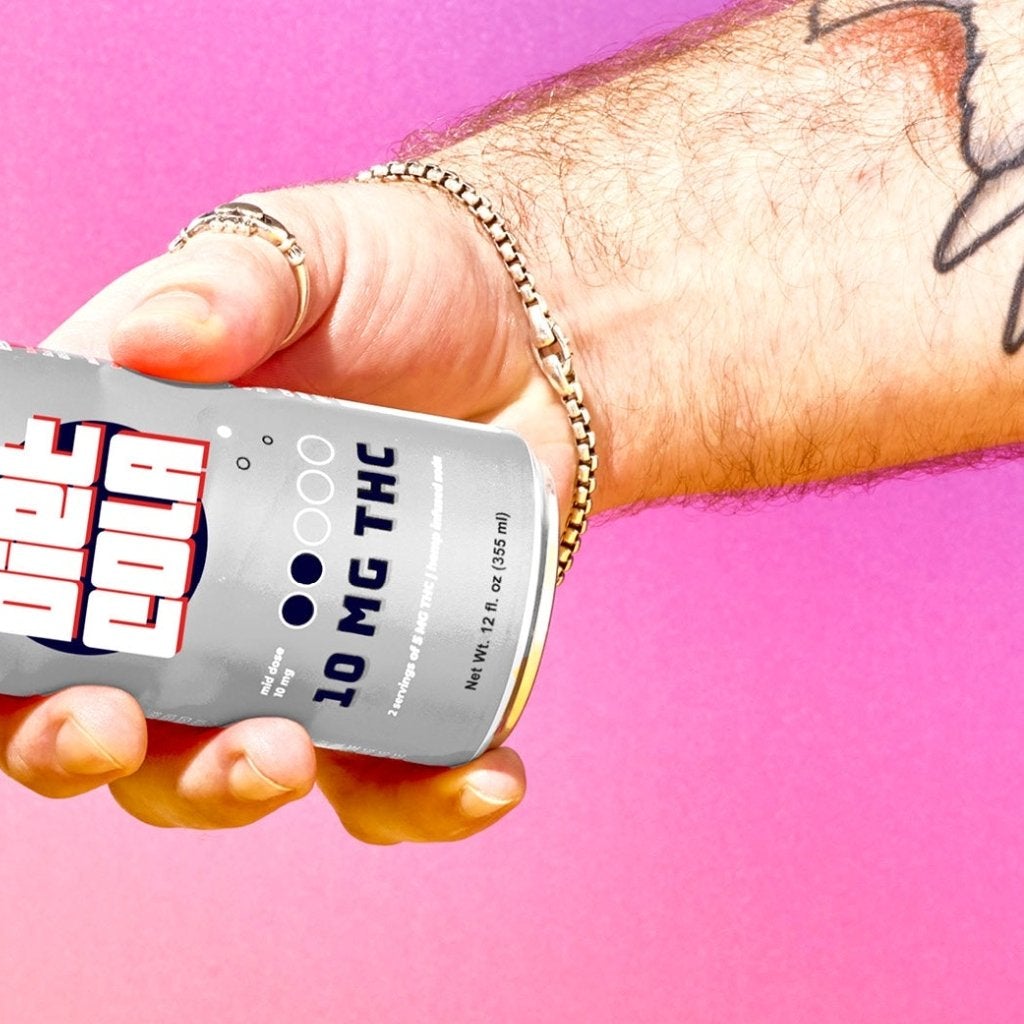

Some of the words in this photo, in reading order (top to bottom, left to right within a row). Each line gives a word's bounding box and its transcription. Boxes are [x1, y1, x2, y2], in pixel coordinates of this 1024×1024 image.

[353, 442, 398, 537] THC
[430, 482, 443, 532] infused
[495, 511, 511, 535] ml)
[426, 531, 443, 570] hemp
[492, 538, 507, 571] (355
[336, 557, 390, 637] MG
[420, 580, 435, 609] THC
[491, 575, 502, 592] oz
[484, 598, 499, 612] fl.
[414, 610, 429, 635] MG
[481, 616, 495, 633] 12
[409, 644, 421, 661] of
[472, 640, 490, 664] Wt.
[260, 675, 275, 696] mid
[268, 646, 285, 676] dose
[273, 687, 286, 698] 10
[280, 668, 296, 687] mg
[312, 652, 366, 708] 10
[464, 666, 483, 691] Net
[392, 662, 416, 710] servings
[387, 709, 398, 717] 2
